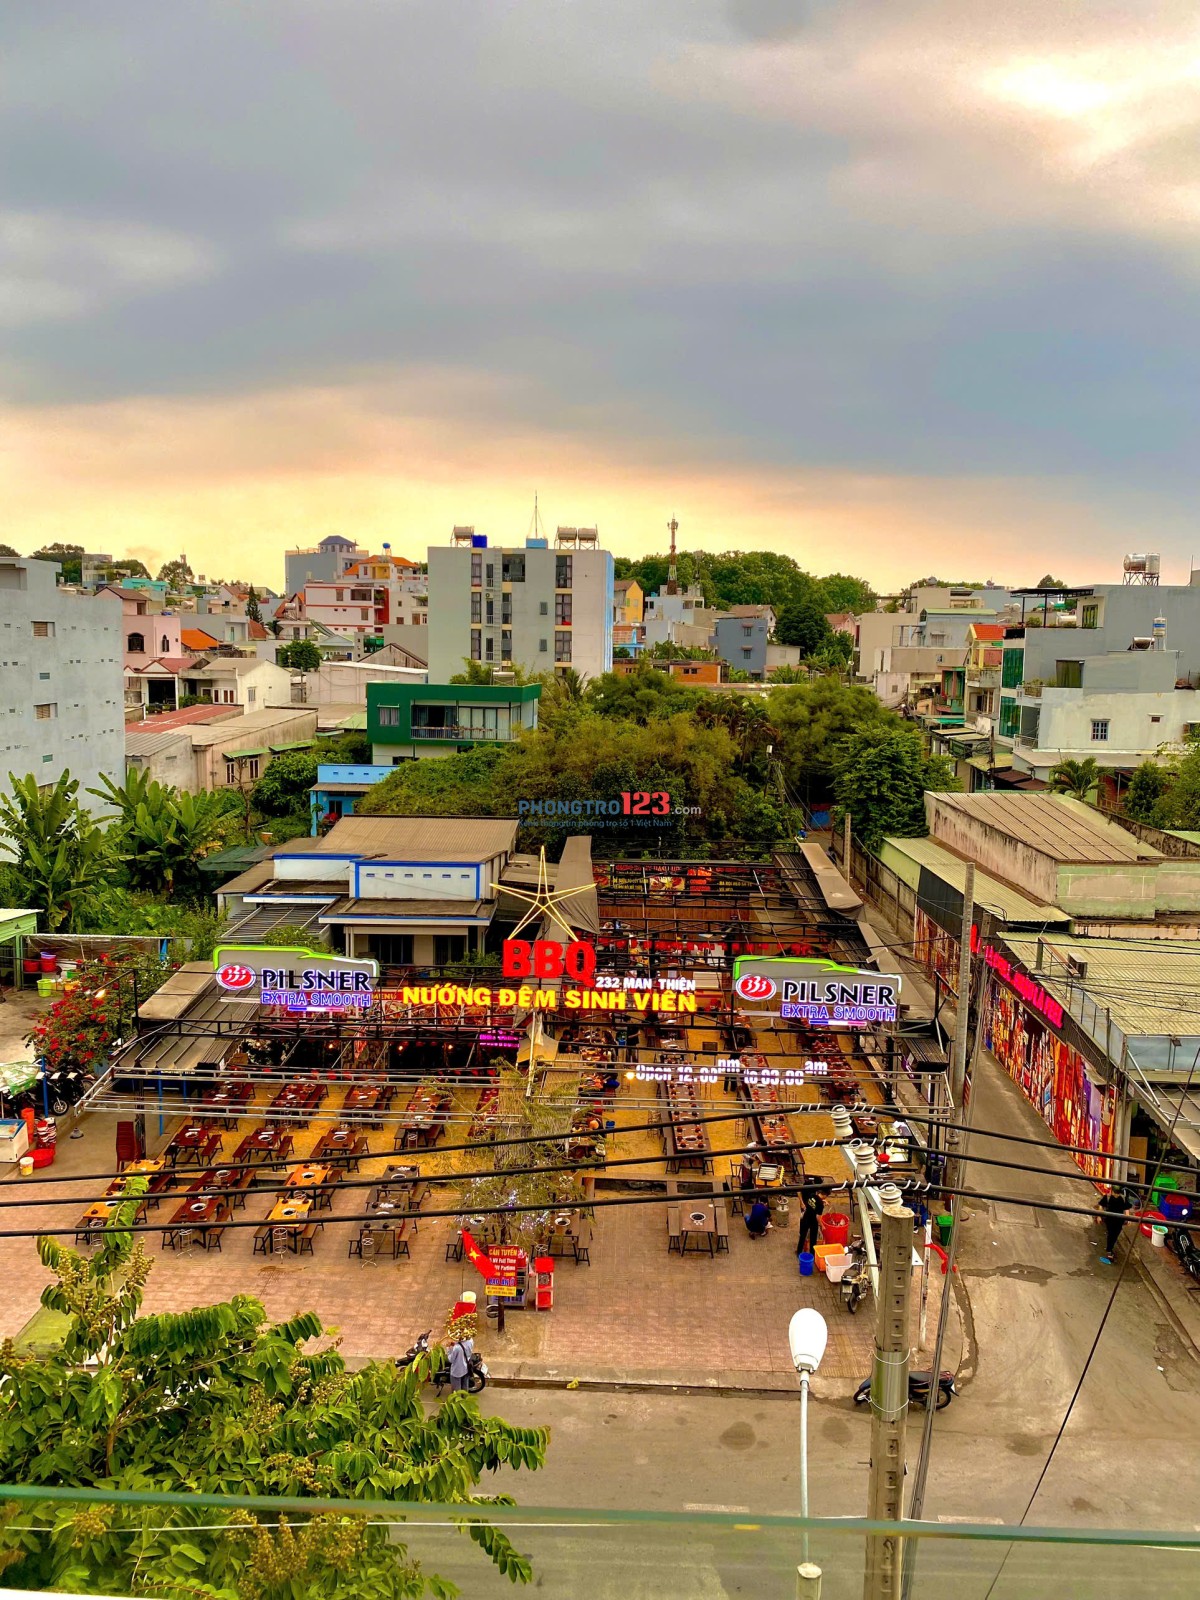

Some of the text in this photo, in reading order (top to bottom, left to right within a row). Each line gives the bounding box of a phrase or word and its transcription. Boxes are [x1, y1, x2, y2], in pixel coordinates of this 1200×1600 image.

[502, 939, 597, 988] BBQ
[261, 968, 374, 992] PILSNER
[595, 976, 697, 993] 232 MAN THIỆN
[261, 991, 372, 1008] EXTRA SMOOTH
[402, 982, 698, 1012] NƯỚNG ĐÊM SINH VIÊN
[781, 980, 898, 1007] PILSNER
[781, 1004, 896, 1022] EXTRA SMOOTH
[636, 1064, 673, 1082] Open
[744, 1068, 758, 1085] to
